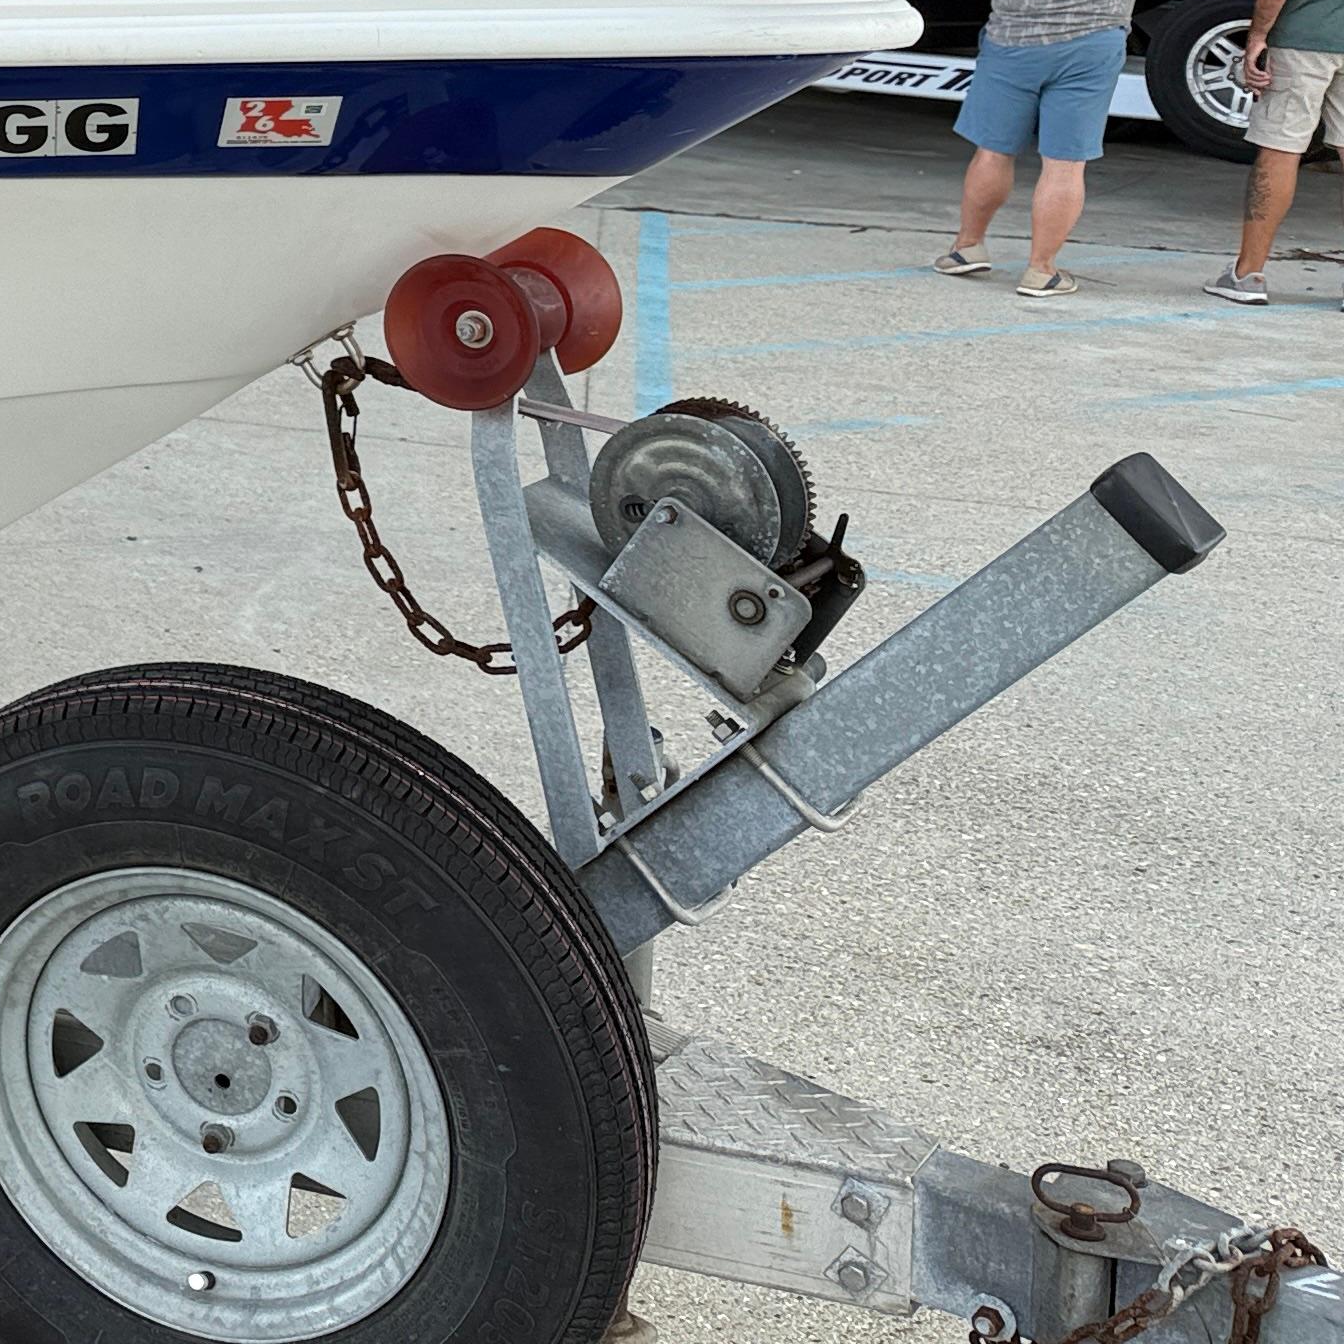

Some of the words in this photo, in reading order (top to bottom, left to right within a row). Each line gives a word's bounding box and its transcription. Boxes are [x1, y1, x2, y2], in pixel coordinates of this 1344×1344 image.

[827, 66, 941, 88] PORT
[16, 766, 180, 825] ROAD
[340, 852, 441, 916] ST
